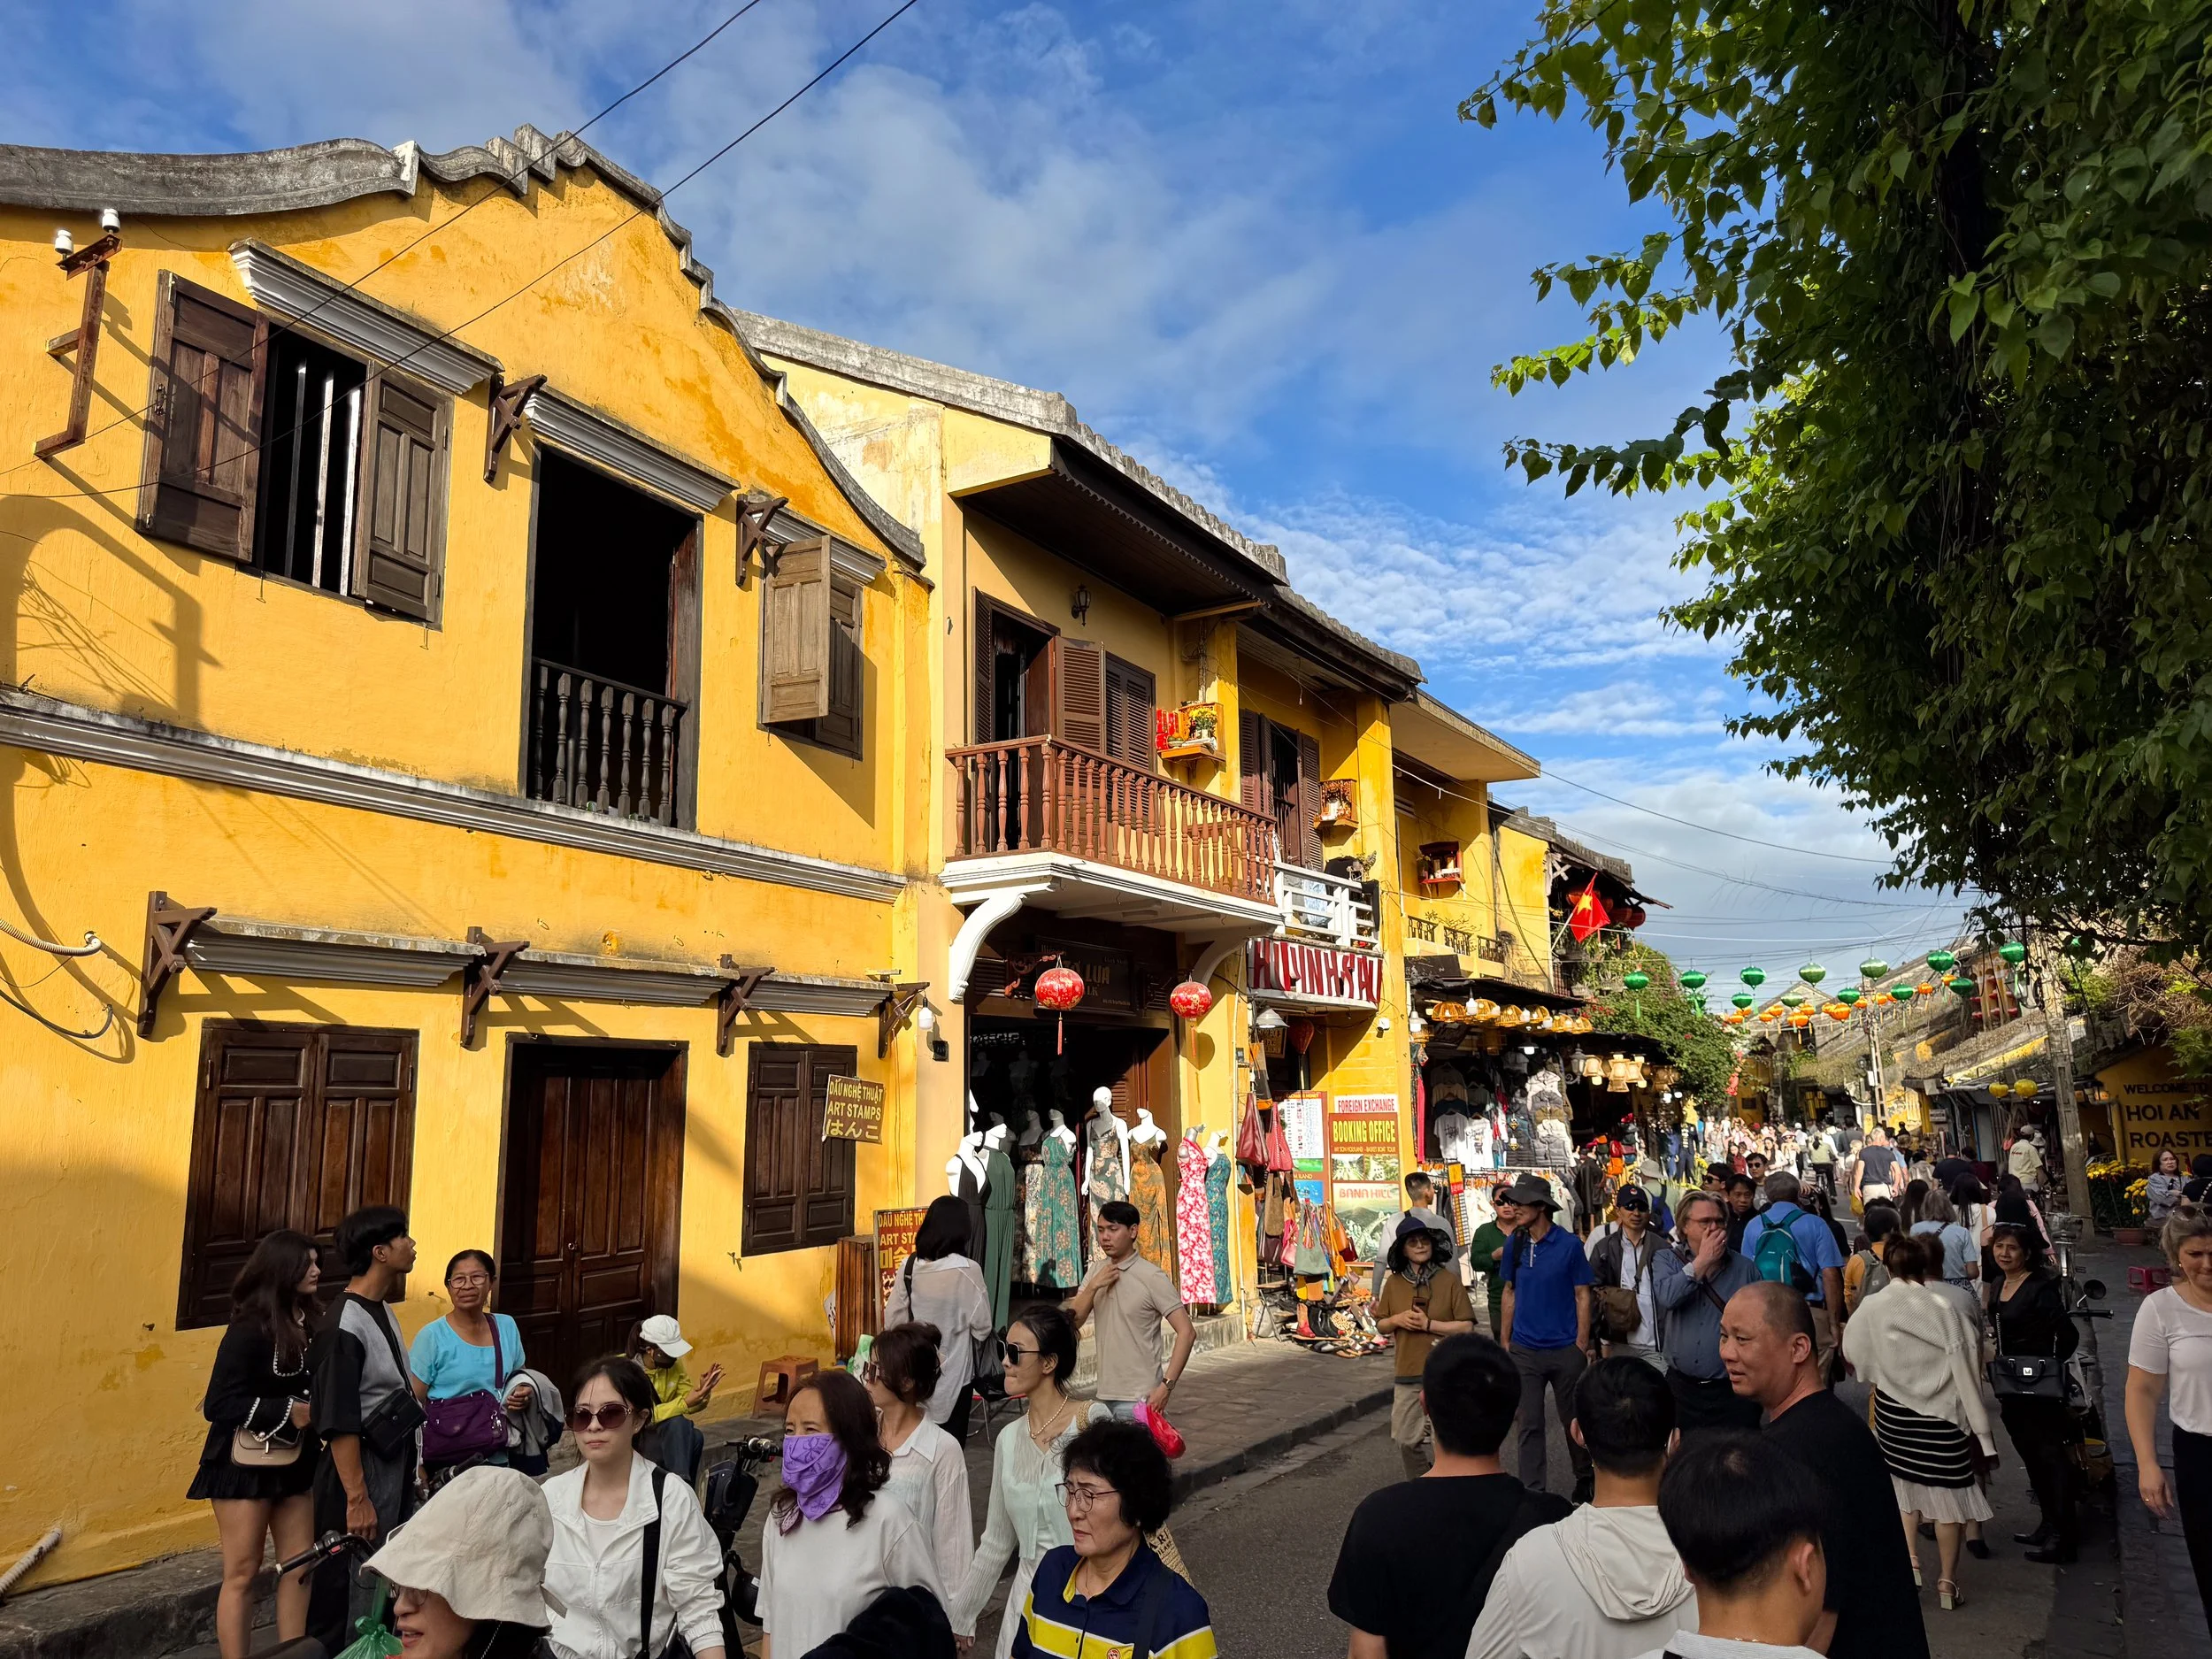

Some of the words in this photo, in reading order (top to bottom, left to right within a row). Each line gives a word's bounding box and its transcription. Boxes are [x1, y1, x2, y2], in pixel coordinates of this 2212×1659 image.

[2124, 1082, 2190, 1094] WELCOME
[827, 1100, 846, 1117] ART
[847, 1102, 882, 1121] STAMPS
[1338, 1100, 1363, 1113] FOREIGN
[1363, 1098, 1395, 1112] EXCHANGE
[2125, 1104, 2163, 1121] HOI
[2169, 1103, 2200, 1120] AN
[826, 1118, 879, 1141] はんこ
[1333, 1120, 1367, 1142] BOOKING
[1368, 1120, 1396, 1142] OFFICE
[1370, 1188, 1393, 1199] HILL
[879, 1233, 899, 1246] ART
